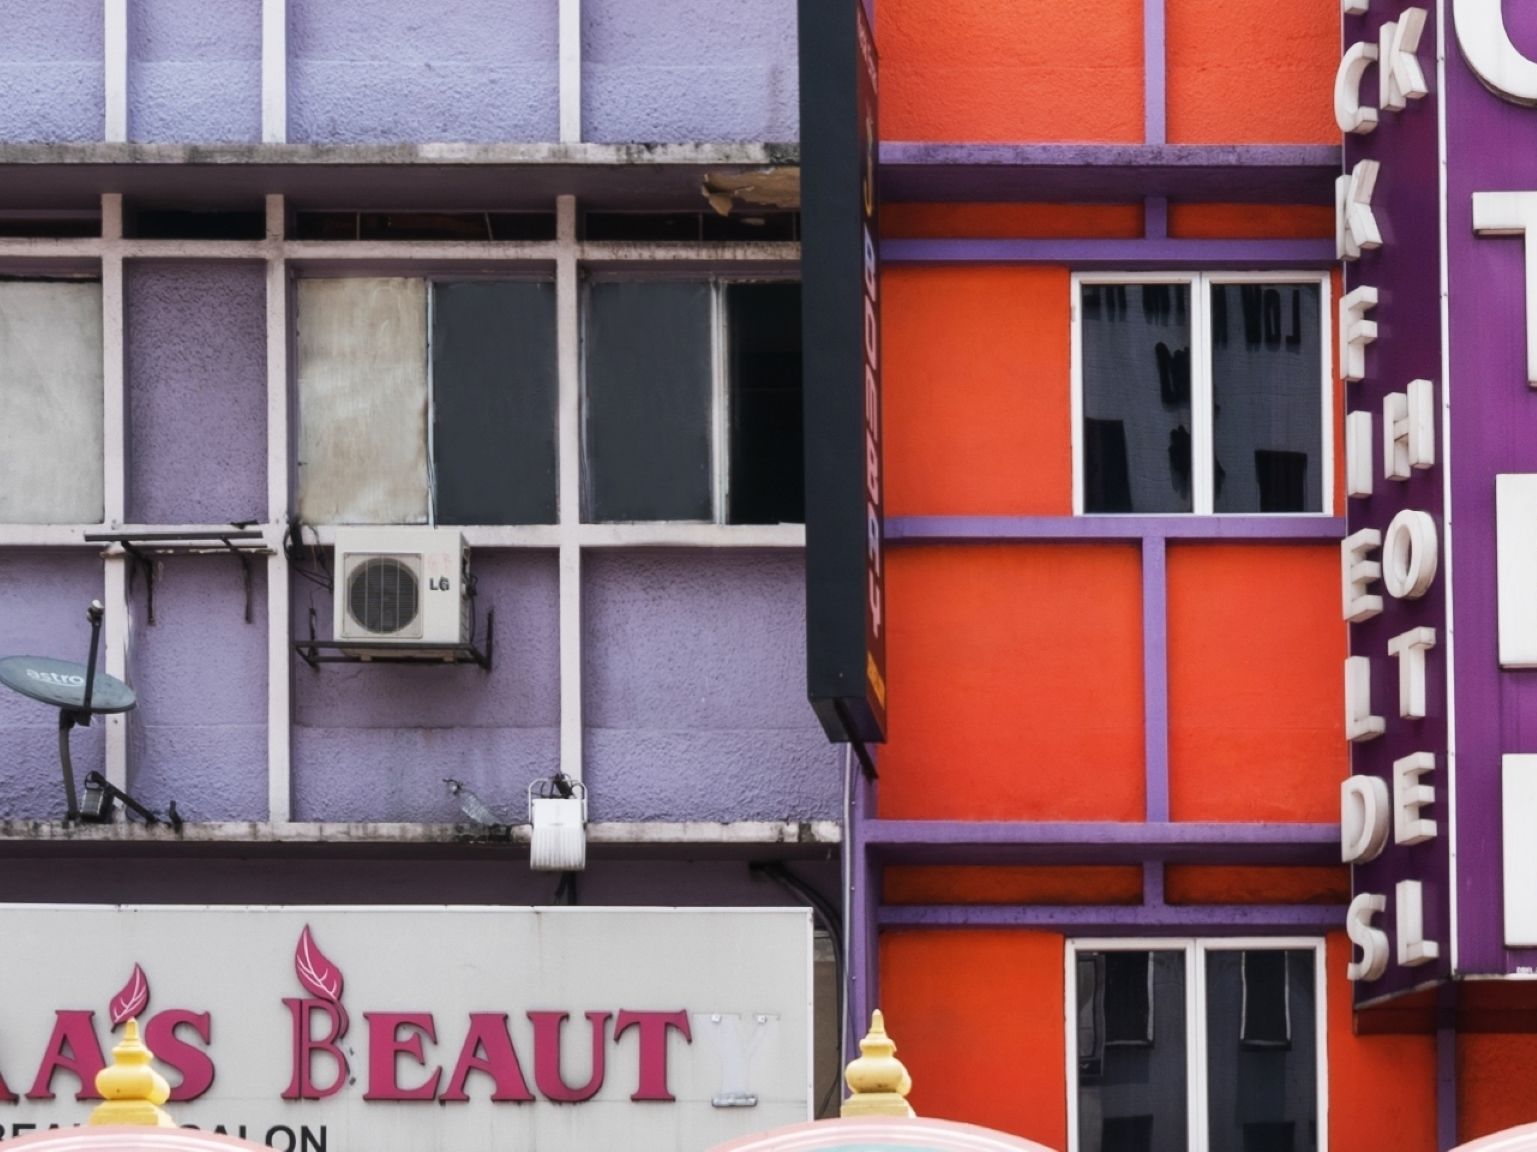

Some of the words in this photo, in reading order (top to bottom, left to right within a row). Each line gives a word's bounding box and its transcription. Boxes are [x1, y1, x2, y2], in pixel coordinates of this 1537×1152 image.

[429, 576, 450, 591] LG
[26, 668, 84, 686] astro
[1382, 379, 1438, 967] HOTEL
